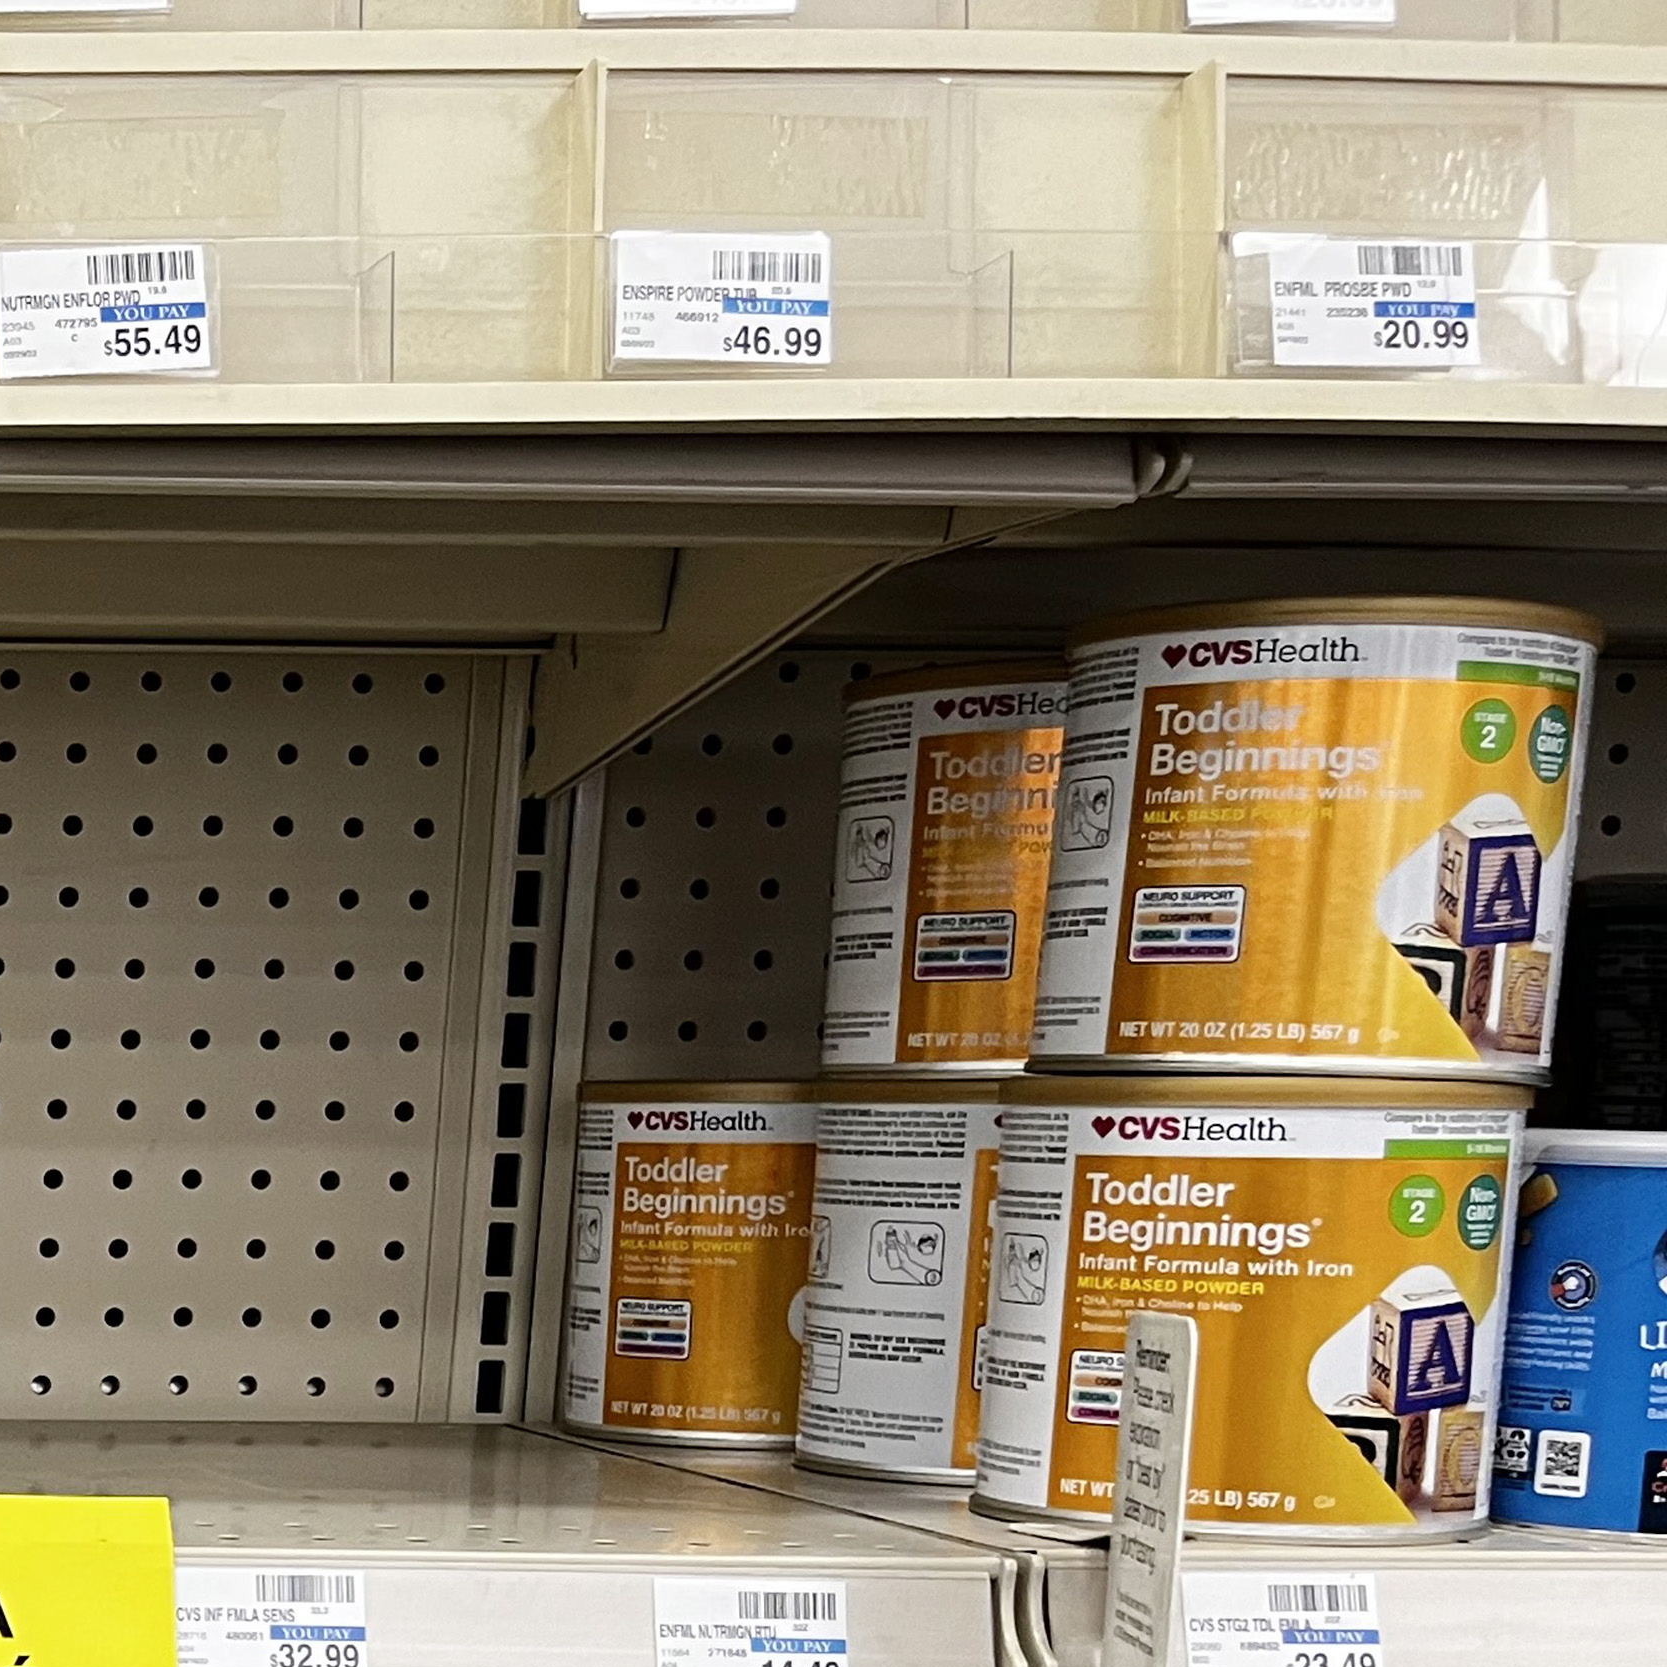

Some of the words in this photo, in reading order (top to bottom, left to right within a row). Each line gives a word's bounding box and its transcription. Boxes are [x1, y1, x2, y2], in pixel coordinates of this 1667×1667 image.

[113, 307, 153, 321] YOU
[158, 305, 189, 319] PAY
[104, 325, 201, 357] $55.49
[724, 325, 821, 356] $46.99
[1375, 320, 1468, 349] $20.99
[1155, 698, 1305, 736] Toddler
[1150, 740, 1381, 781] Beginnings
[625, 1156, 728, 1183] Toddler
[623, 1187, 785, 1220] Beginnings
[1086, 1173, 1235, 1207] Toddler
[1083, 1210, 1310, 1255] Beginnings
[1079, 1253, 1137, 1271] Infant
[1145, 1255, 1239, 1275] Formula
[1248, 1259, 1298, 1276] with
[1308, 1260, 1353, 1277] Iron
[1077, 1276, 1177, 1293] MILK-BASED
[1183, 1279, 1264, 1295] POWDER
